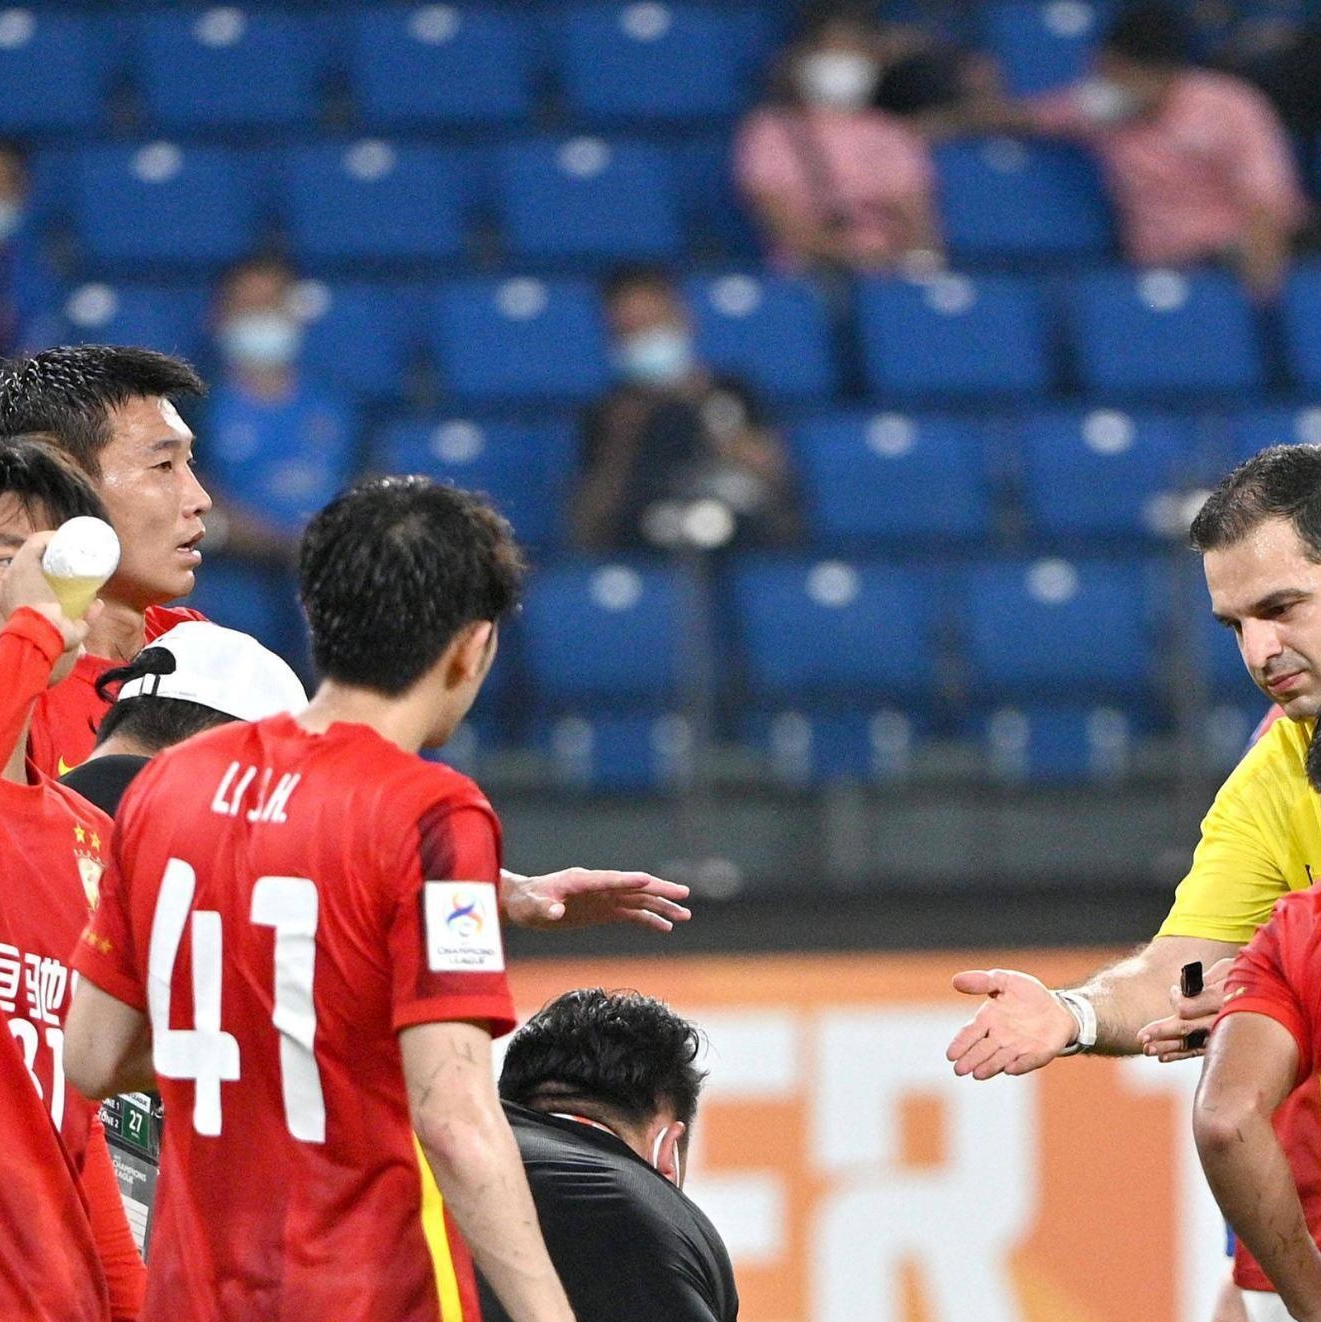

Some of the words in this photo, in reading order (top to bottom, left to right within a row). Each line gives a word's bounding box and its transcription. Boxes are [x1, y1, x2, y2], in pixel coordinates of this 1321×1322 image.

[211, 760, 257, 816] LI
[148, 857, 326, 1144] 41
[129, 1109, 143, 1133] 27
